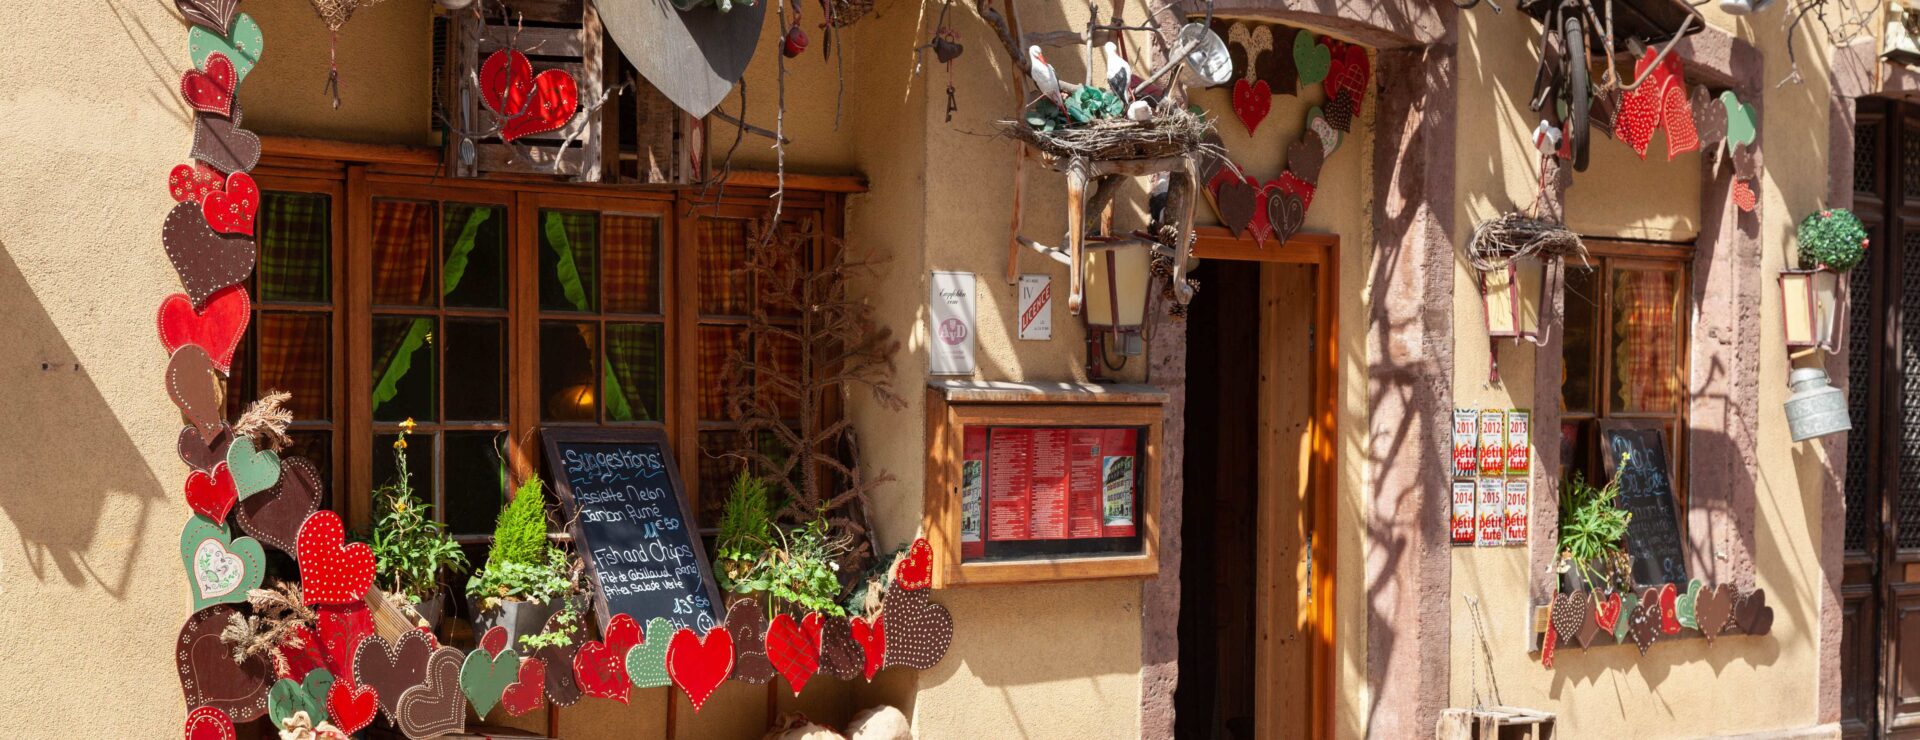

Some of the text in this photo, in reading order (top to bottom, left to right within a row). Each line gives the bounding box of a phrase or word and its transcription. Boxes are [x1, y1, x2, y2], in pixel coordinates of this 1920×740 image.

[1024, 286, 1034, 300] IV
[1022, 285, 1050, 330] LICENCE
[1456, 422, 1474, 434] 2011
[1483, 422, 1501, 434] 2012
[1510, 421, 1527, 433] 2013
[1453, 444, 1477, 459] petit
[1479, 444, 1504, 459] petit
[1506, 444, 1529, 459] petit
[1456, 459, 1476, 471] futé
[1483, 459, 1504, 471] futé
[1510, 459, 1529, 471] futé
[1455, 492, 1473, 504] 2014
[1482, 492, 1500, 504] 2015
[1507, 493, 1526, 506] 2016
[580, 503, 662, 525] Jambon fumé
[1505, 512, 1527, 527] petit
[1451, 514, 1475, 529] petit
[1479, 514, 1503, 529] petit
[1454, 528, 1475, 542] futé
[1482, 527, 1502, 541] futé
[1508, 526, 1527, 539] futé
[594, 539, 694, 570] Fish and Chips
